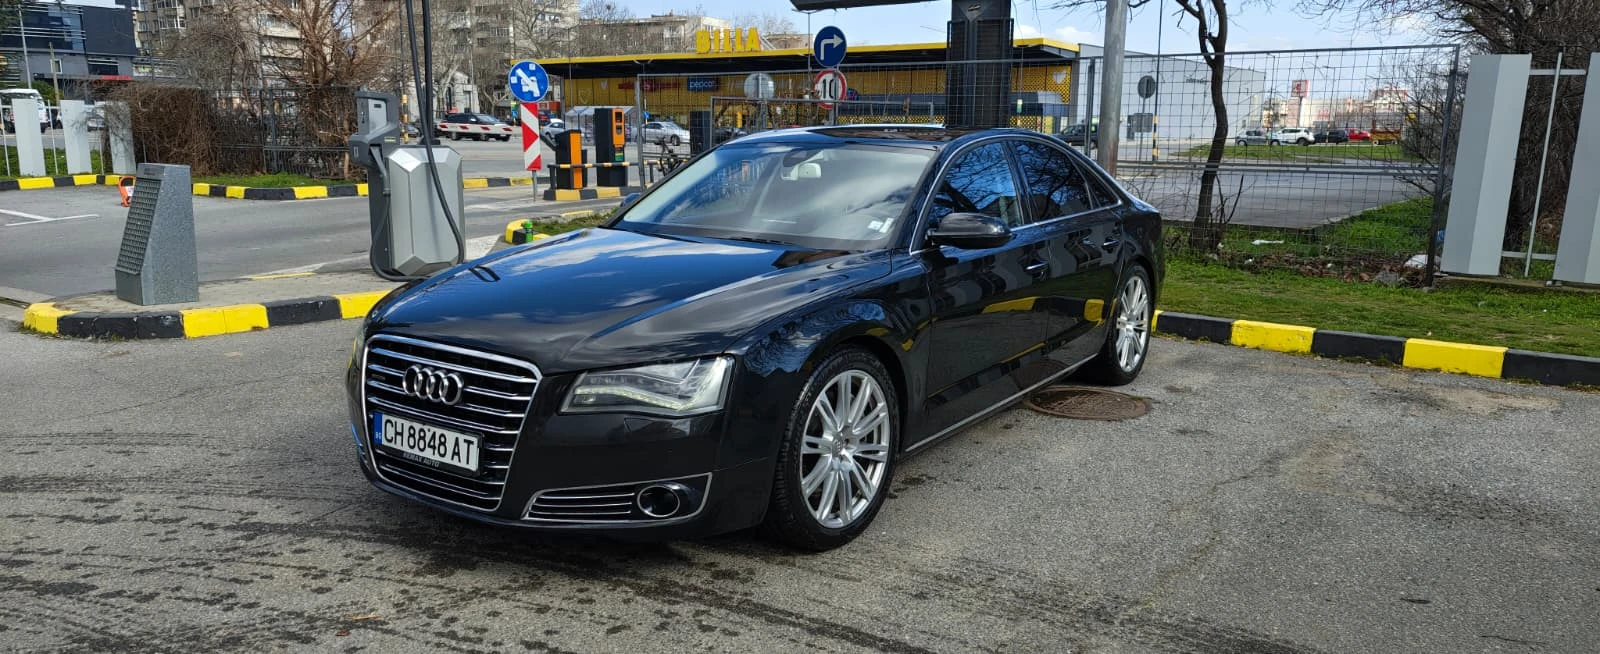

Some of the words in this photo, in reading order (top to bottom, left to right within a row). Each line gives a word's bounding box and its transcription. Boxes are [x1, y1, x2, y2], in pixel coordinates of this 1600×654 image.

[695, 27, 761, 54] BILLA
[384, 419, 404, 447] CH
[407, 425, 447, 458] 8848
[451, 436, 474, 465] AT
